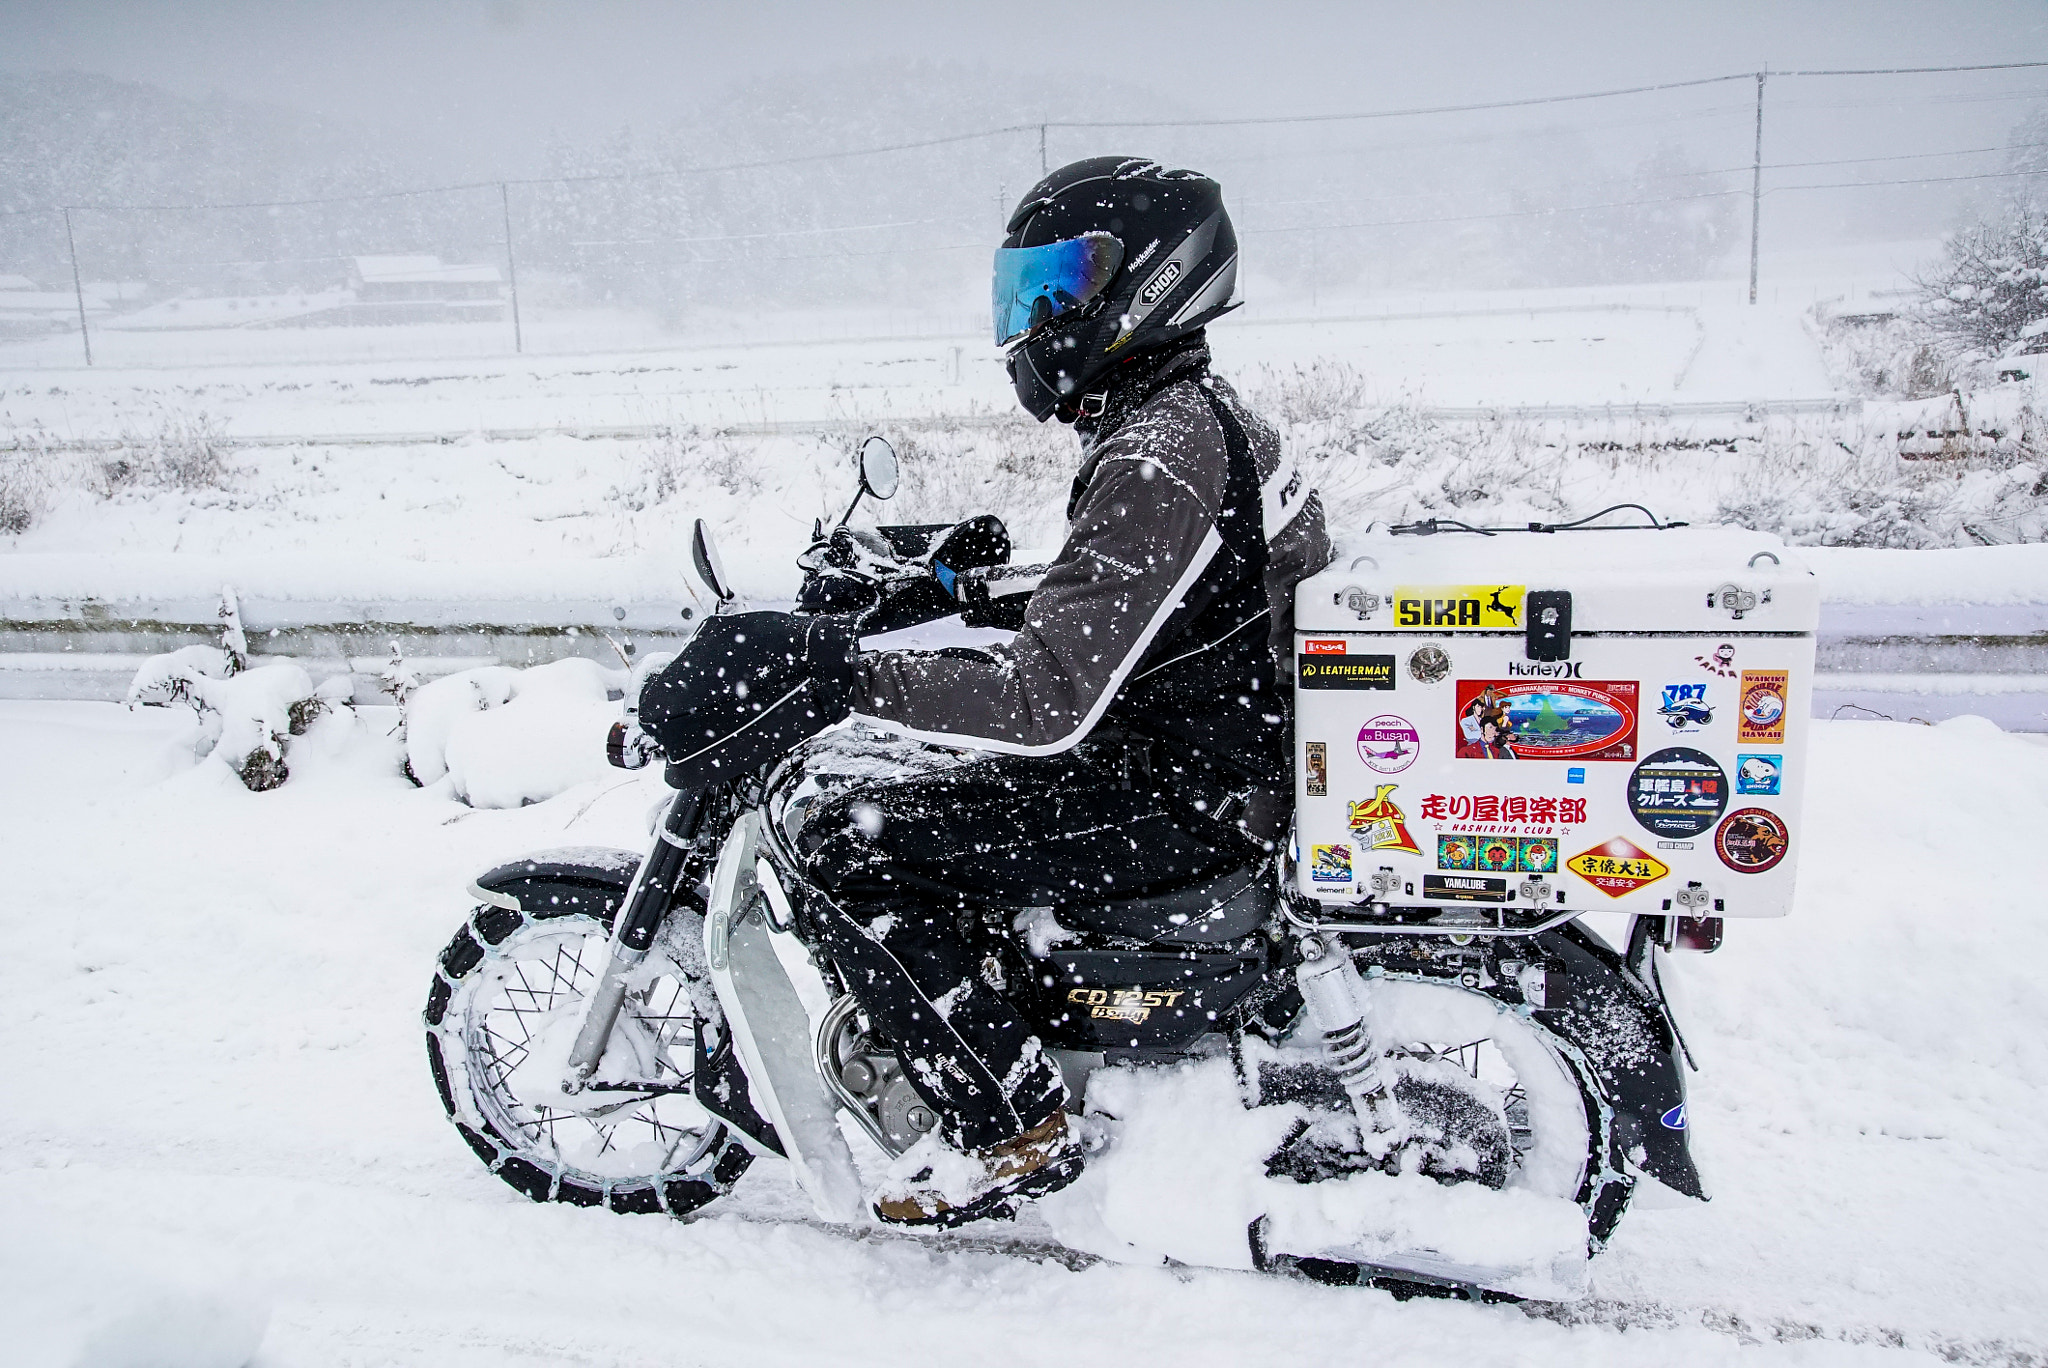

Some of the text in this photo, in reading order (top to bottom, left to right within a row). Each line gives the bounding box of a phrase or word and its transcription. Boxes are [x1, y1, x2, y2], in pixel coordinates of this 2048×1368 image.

[1144, 263, 1180, 302] SHOEI
[1400, 599, 1480, 626] SIKA
[1320, 665, 1391, 675] LEATHERMAN
[1509, 661, 1563, 677] Hurley
[1665, 684, 1707, 702] 787
[1374, 730, 1410, 742] Busan
[1637, 793, 1688, 807] クルーズ
[1421, 793, 1587, 825] 走り屋倶楽部
[1452, 823, 1553, 835] HASHIRIYA CLUB
[1582, 857, 1652, 877] 宗像大社
[1316, 886, 1345, 894] element
[1444, 877, 1487, 890] YAMALUBE
[1596, 877, 1637, 888] 交通安全
[1067, 988, 1185, 1007] CD 125T
